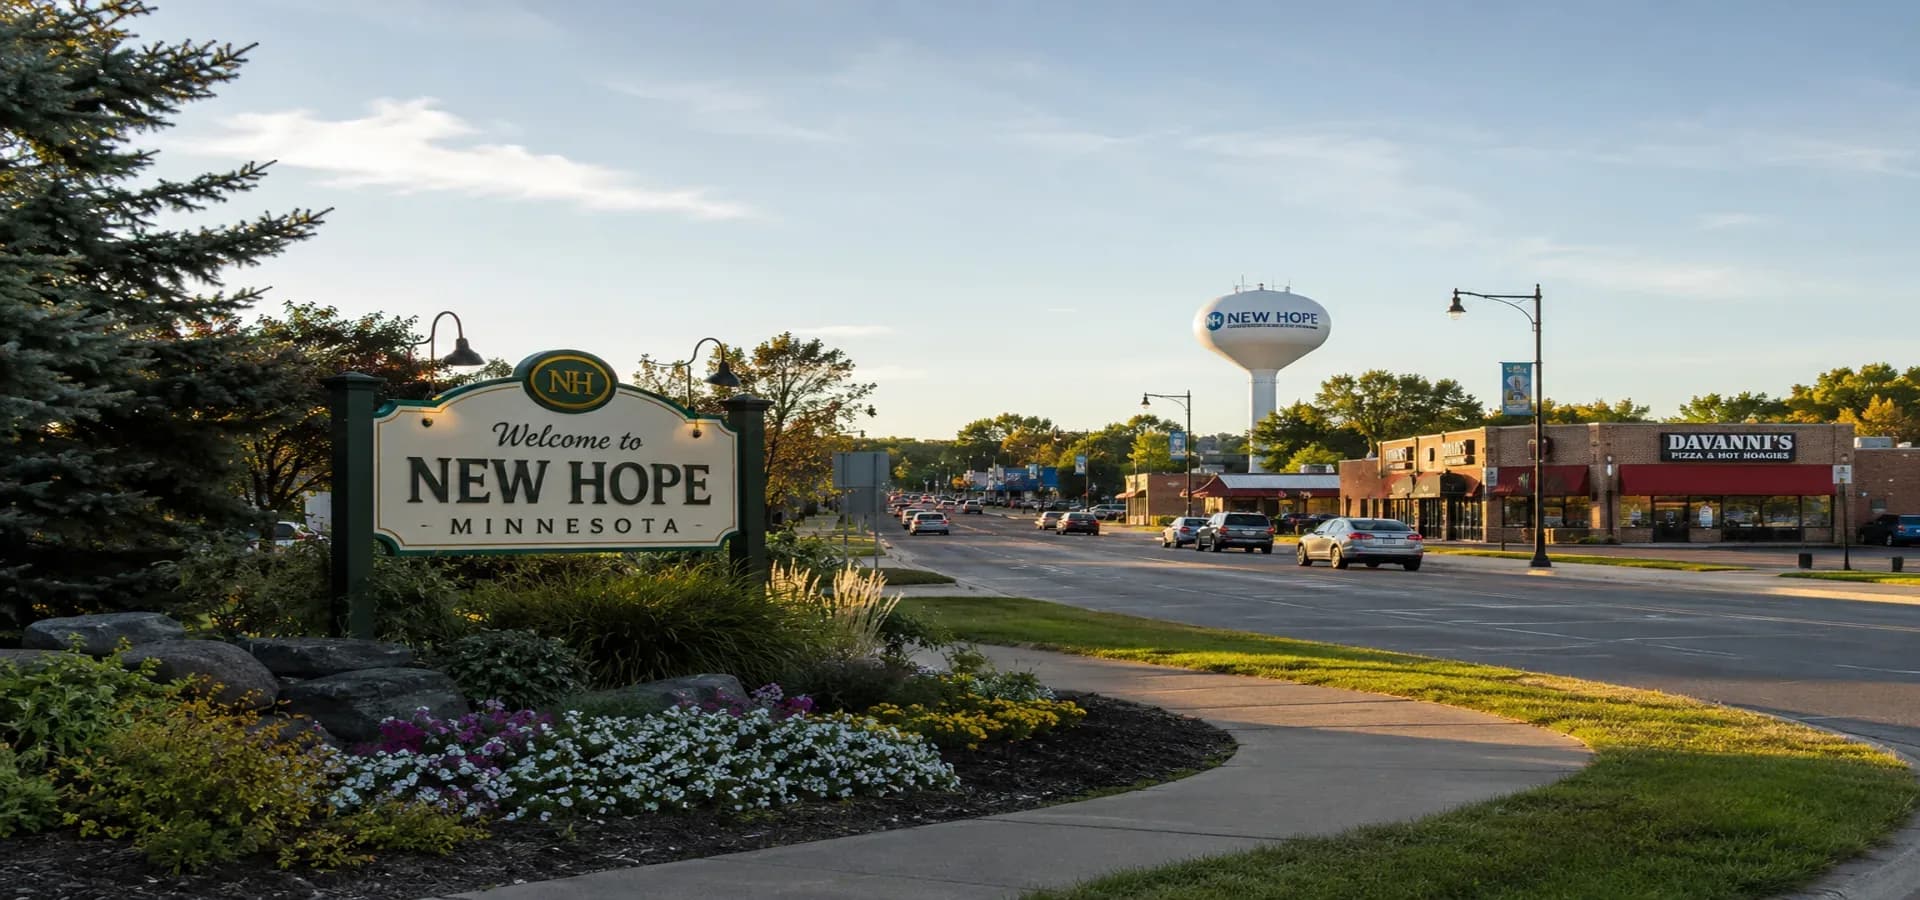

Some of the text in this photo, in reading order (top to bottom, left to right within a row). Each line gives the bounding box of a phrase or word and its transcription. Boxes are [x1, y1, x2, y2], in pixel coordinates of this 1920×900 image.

[1227, 311, 1318, 325] NEW HOPE
[548, 369, 594, 395] NH
[492, 422, 643, 450] Welcome to
[1668, 435, 1793, 450] DAVANNI'S
[407, 456, 712, 506] NEW HOPE
[450, 517, 679, 535] MINNESOTA
